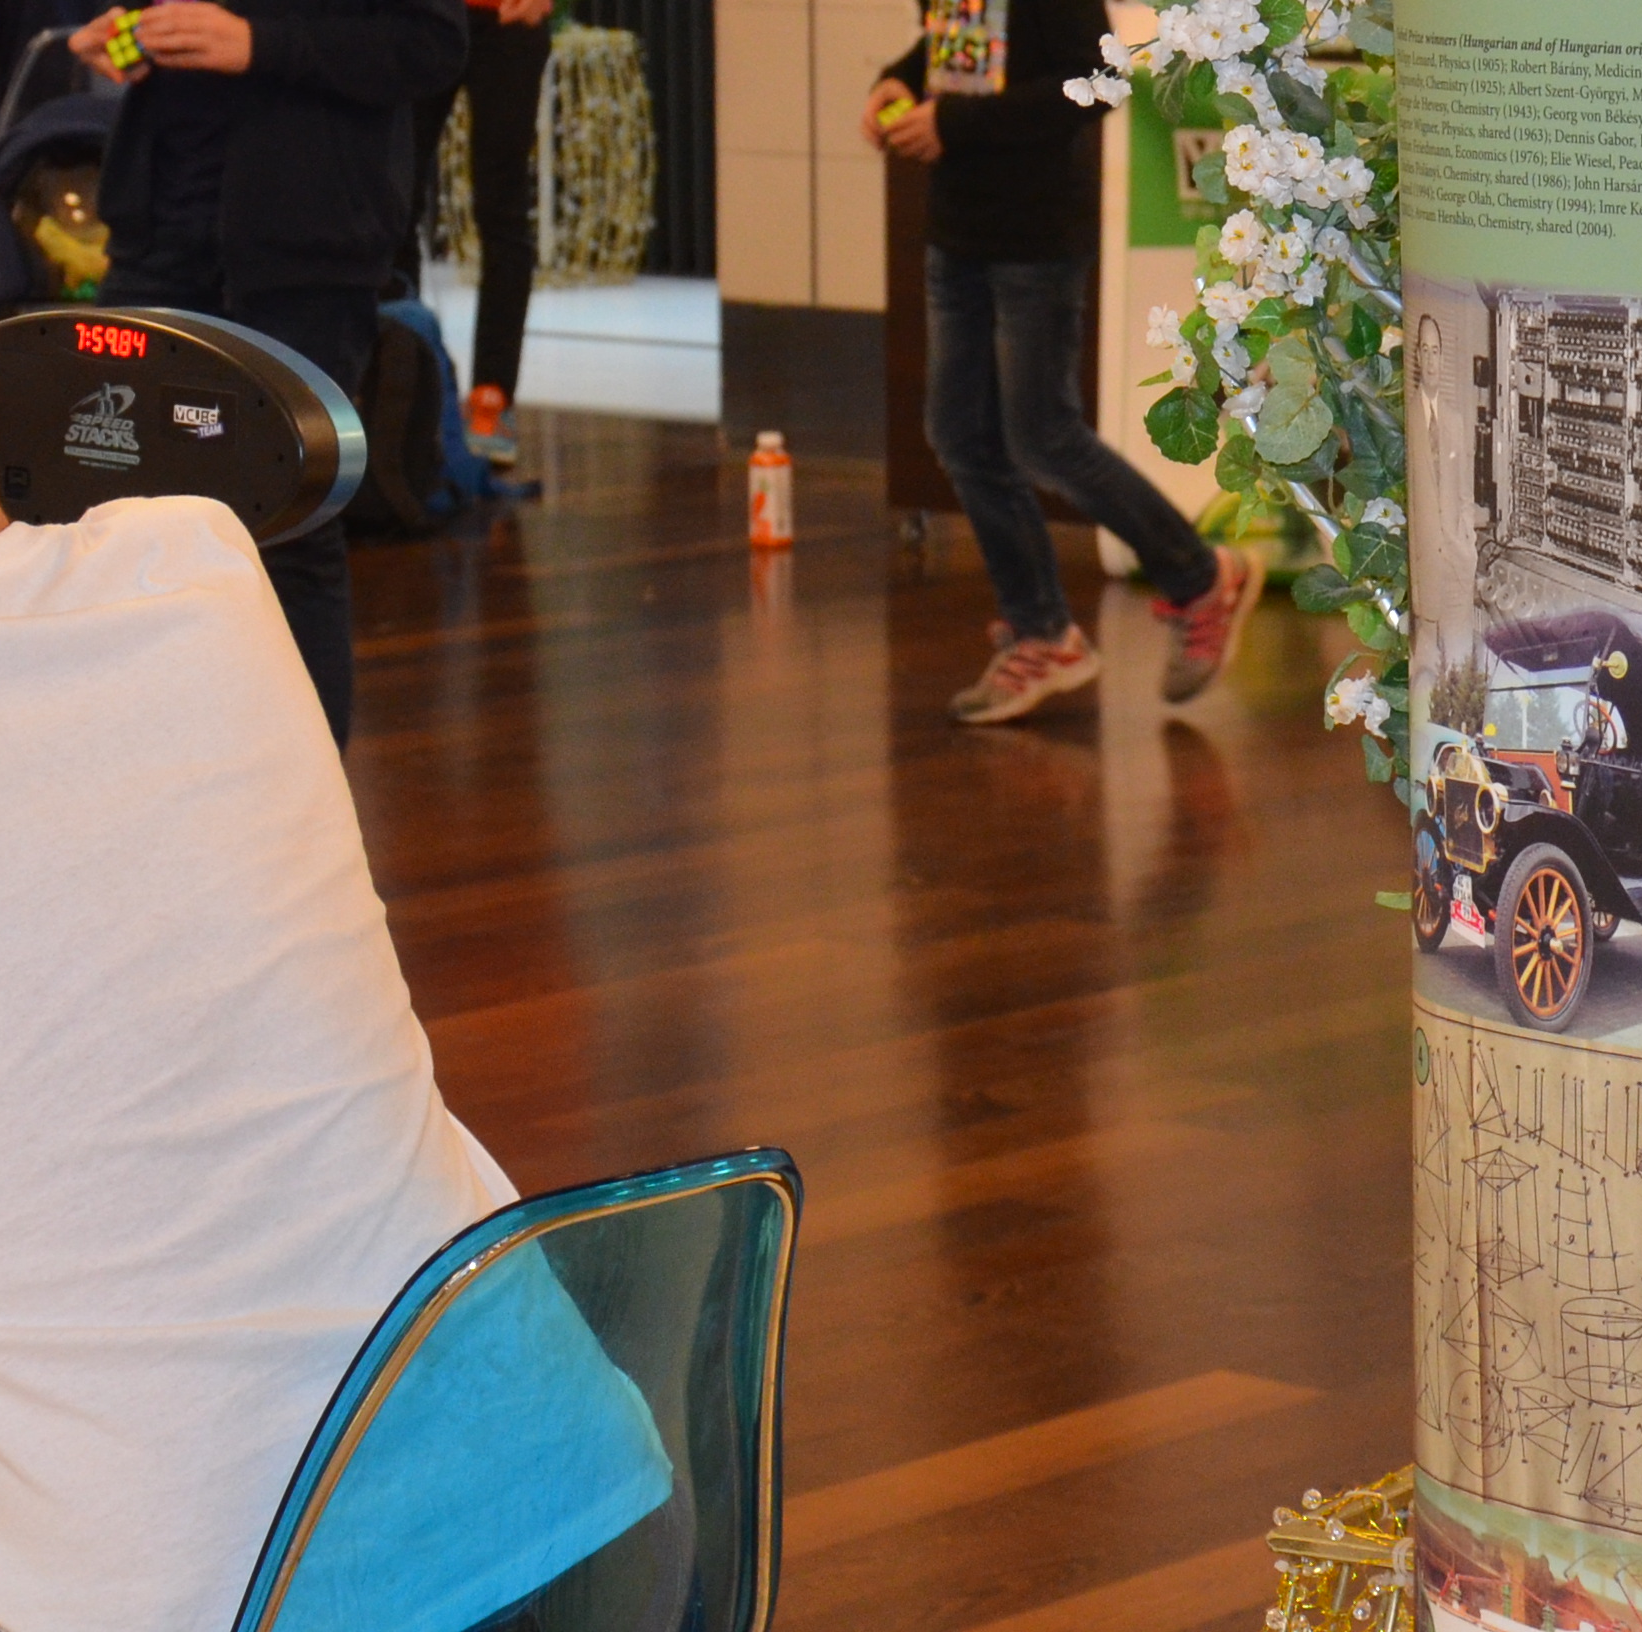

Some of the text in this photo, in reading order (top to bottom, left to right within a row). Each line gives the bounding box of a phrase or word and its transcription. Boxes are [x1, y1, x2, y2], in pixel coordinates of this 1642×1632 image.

[79, 414, 134, 431] SPEED
[198, 423, 223, 438] TEAM
[64, 424, 139, 451] STACKS
